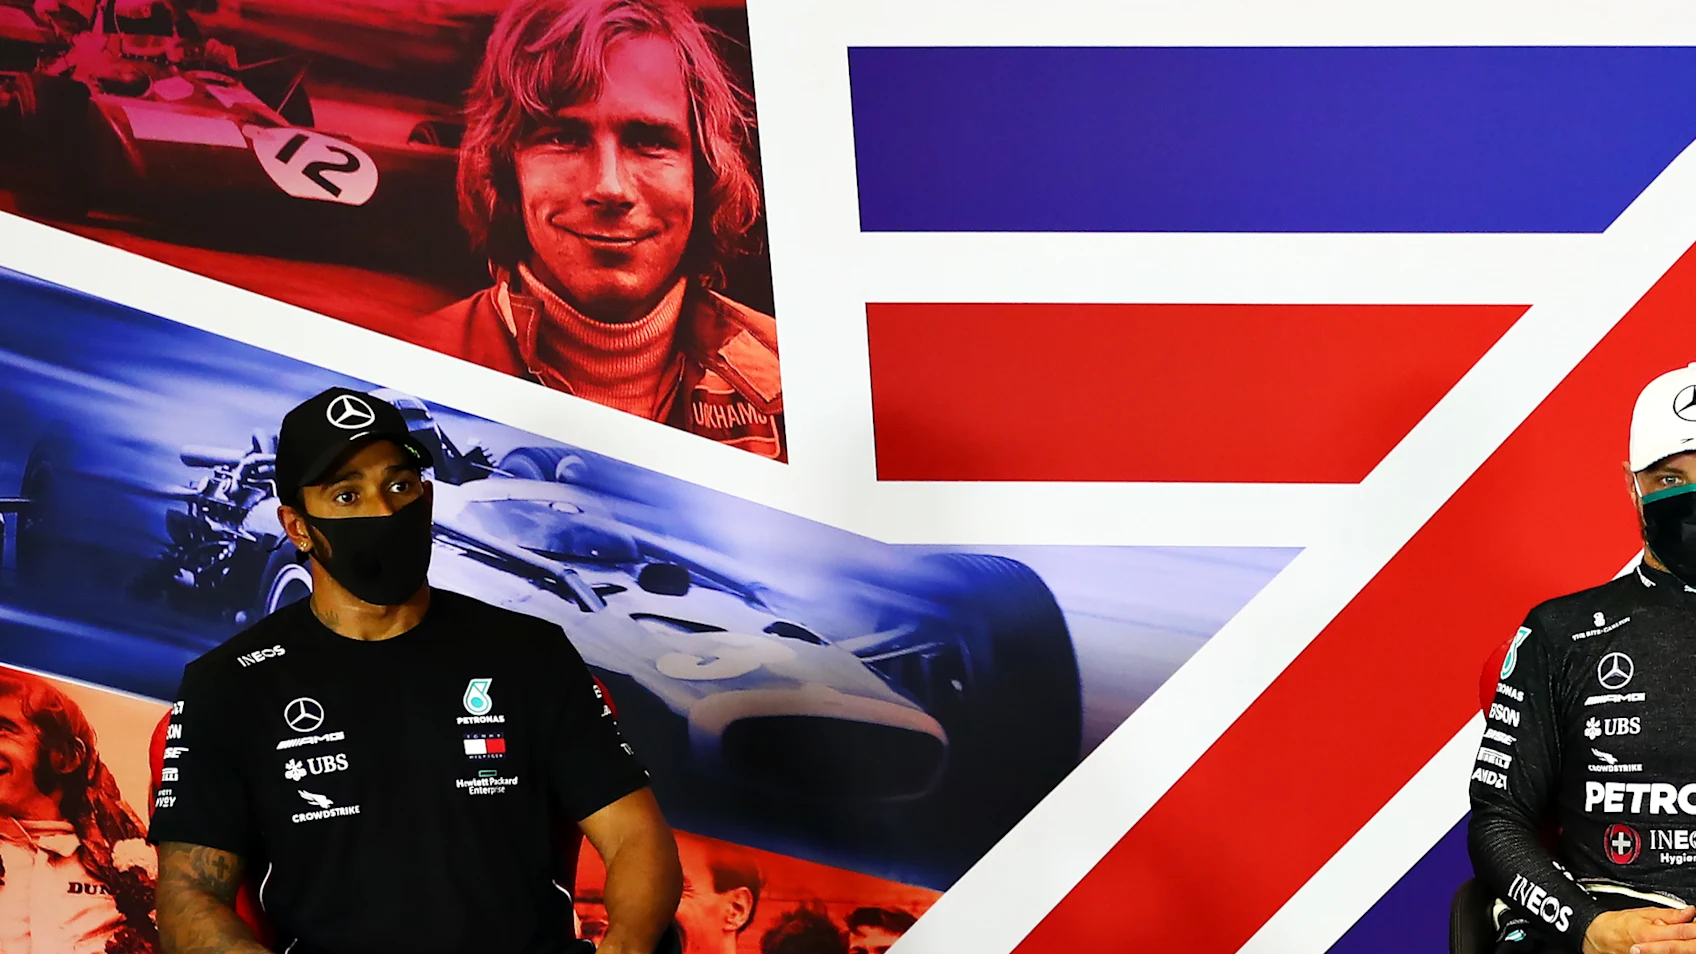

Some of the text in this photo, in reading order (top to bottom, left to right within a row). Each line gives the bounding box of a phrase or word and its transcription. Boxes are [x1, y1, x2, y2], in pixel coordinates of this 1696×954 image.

[275, 133, 361, 198] 12
[237, 645, 286, 667] INEOS
[456, 715, 505, 725] PETRONAS
[1604, 716, 1641, 736] UBS
[306, 753, 349, 775] UBS
[1588, 764, 1643, 772] CROWDSTRIKE
[456, 778, 489, 788] Hewlett
[291, 805, 360, 823] CROWDSTRIKE
[1508, 873, 1574, 932] INEOS
